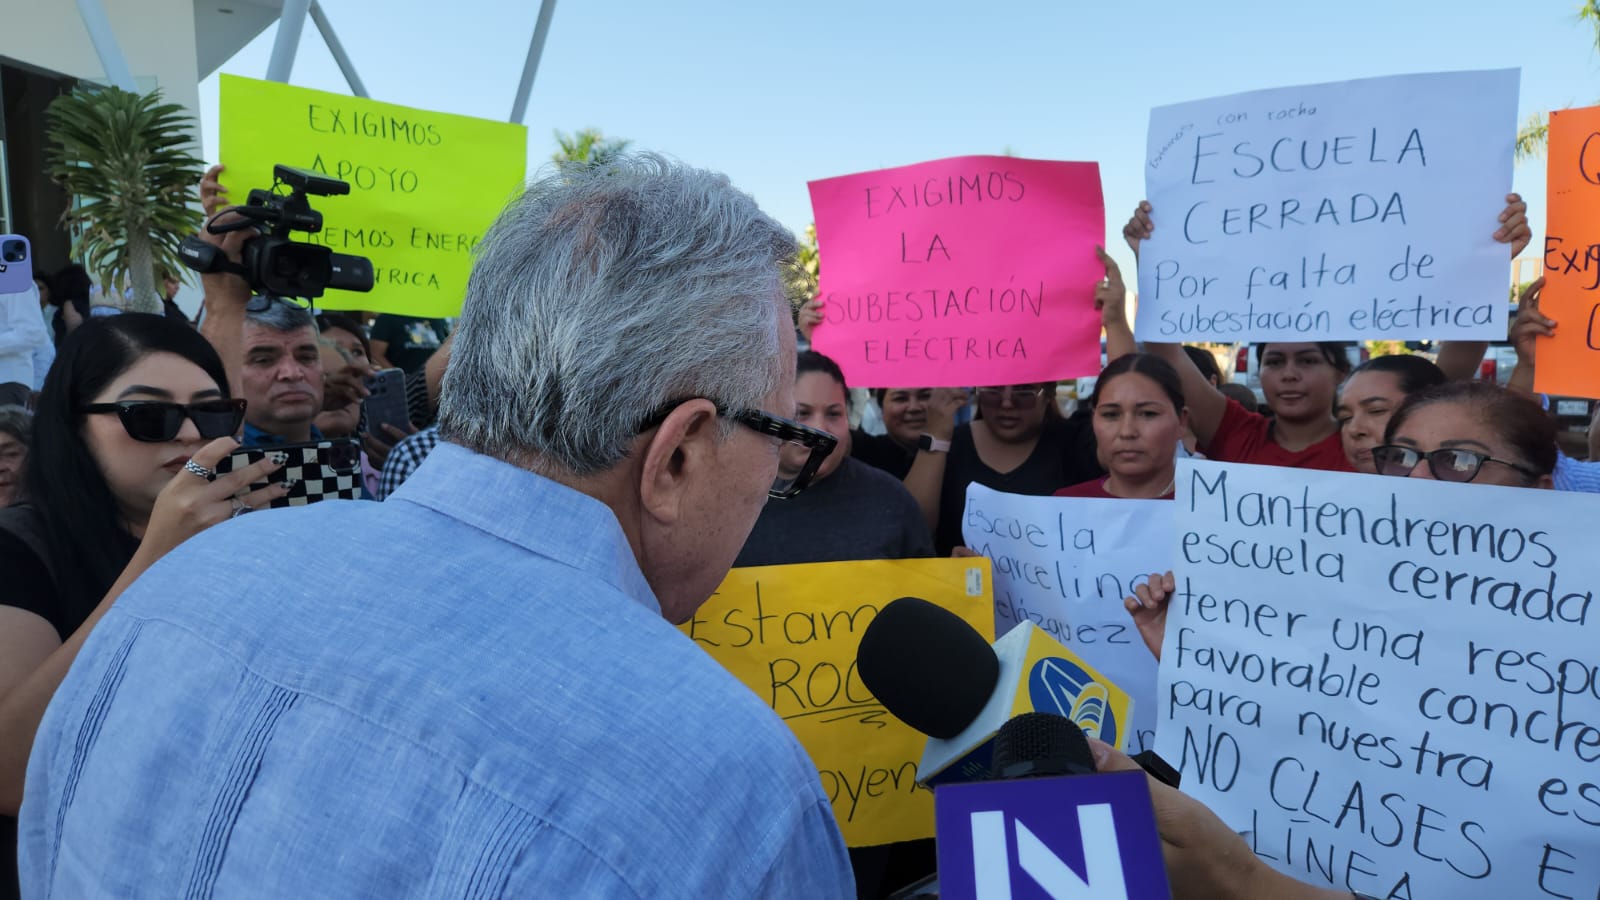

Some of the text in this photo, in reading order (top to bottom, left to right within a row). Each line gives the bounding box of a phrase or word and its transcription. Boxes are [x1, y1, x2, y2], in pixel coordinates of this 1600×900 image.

[309, 104, 442, 146] EXIGIMOS
[312, 153, 419, 193] APOYO
[1191, 127, 1428, 185] ESCUELA
[864, 172, 1026, 219] EXIGIMOS
[1183, 192, 1407, 244] CERRADA
[901, 232, 951, 264] LA
[1154, 245, 1436, 300] Por falta de
[826, 276, 1044, 325] SUBESTACIÓN
[1159, 296, 1495, 336] subestación eléctrica
[865, 329, 1028, 364] ELÉCTRICA
[967, 498, 1096, 555] Escuela
[1190, 469, 1558, 569] Mantendremos
[1182, 531, 1593, 626] escuela cerrada
[1178, 576, 1308, 637] tener
[1333, 618, 1425, 666] una
[1176, 627, 1381, 705] favorable
[1169, 680, 1262, 728] para
[1298, 711, 1494, 791] nuestra
[1179, 724, 1240, 792] NO
[1270, 757, 1492, 879] CLASES
[970, 803, 1129, 900] N
